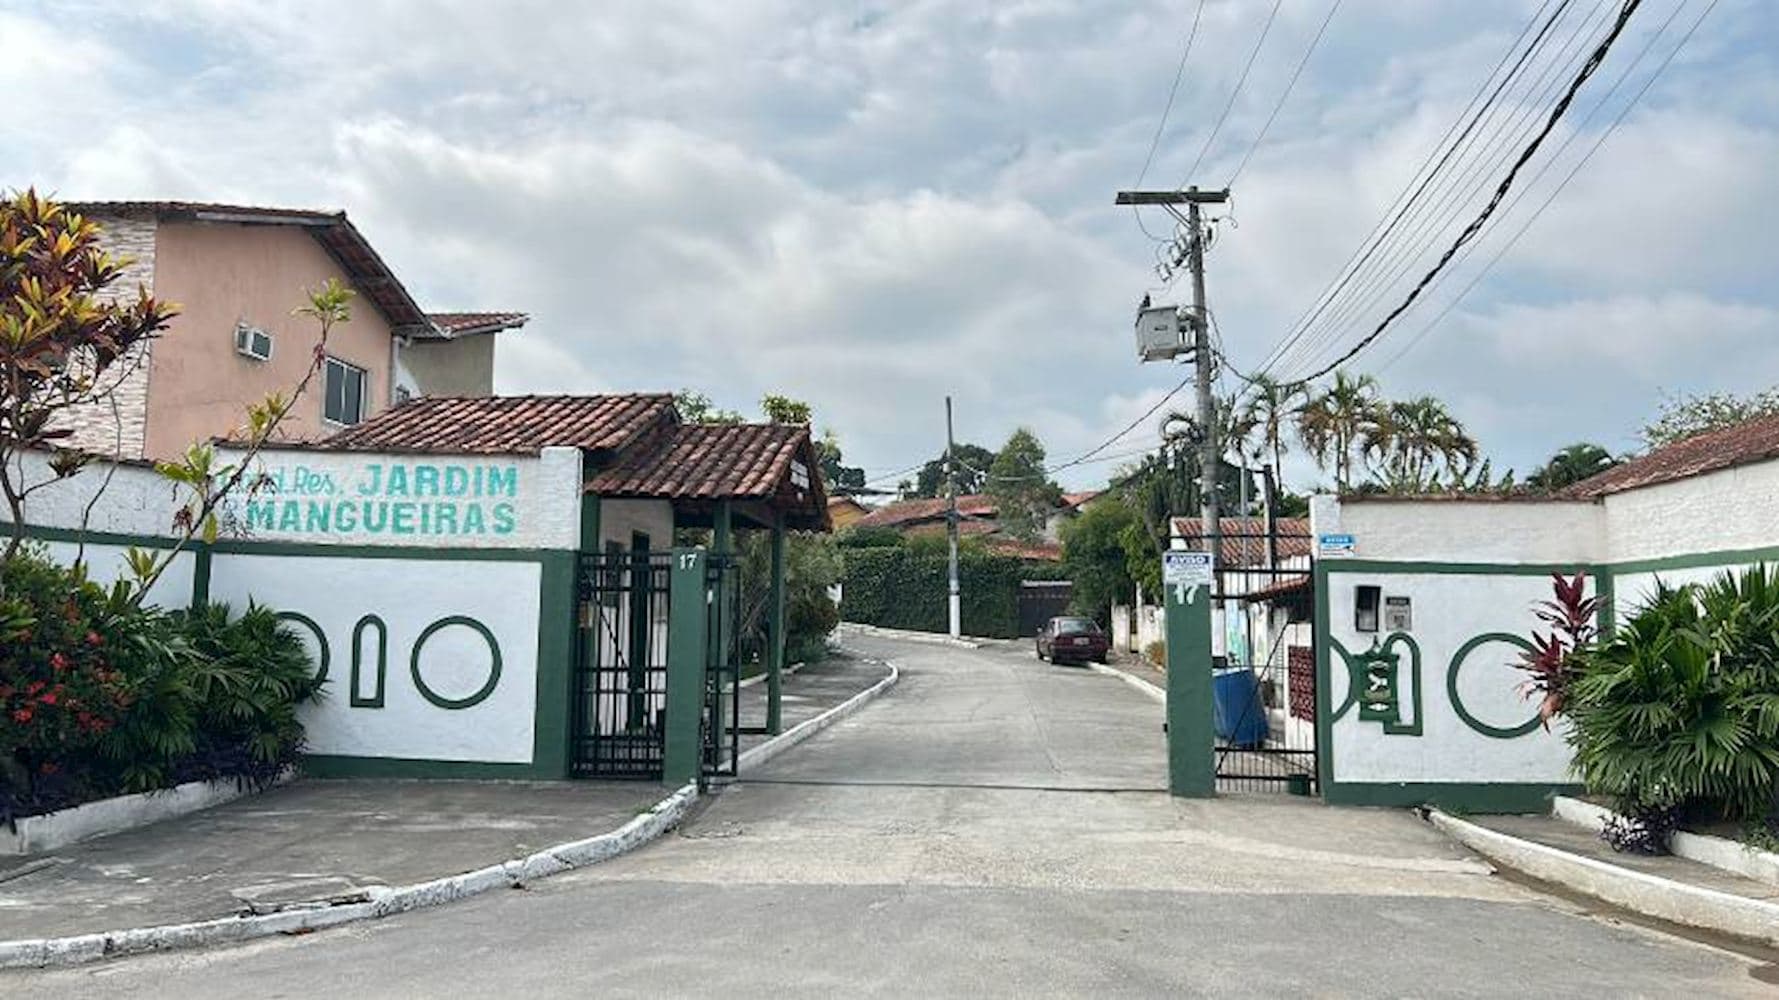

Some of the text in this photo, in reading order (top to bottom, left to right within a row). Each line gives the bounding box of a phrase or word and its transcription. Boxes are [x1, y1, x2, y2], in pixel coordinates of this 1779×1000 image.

[357, 463, 518, 497] JARDIM
[246, 499, 516, 534] MANGUEIRAS
[680, 553, 698, 570] 17
[1173, 583, 1200, 605] 17
